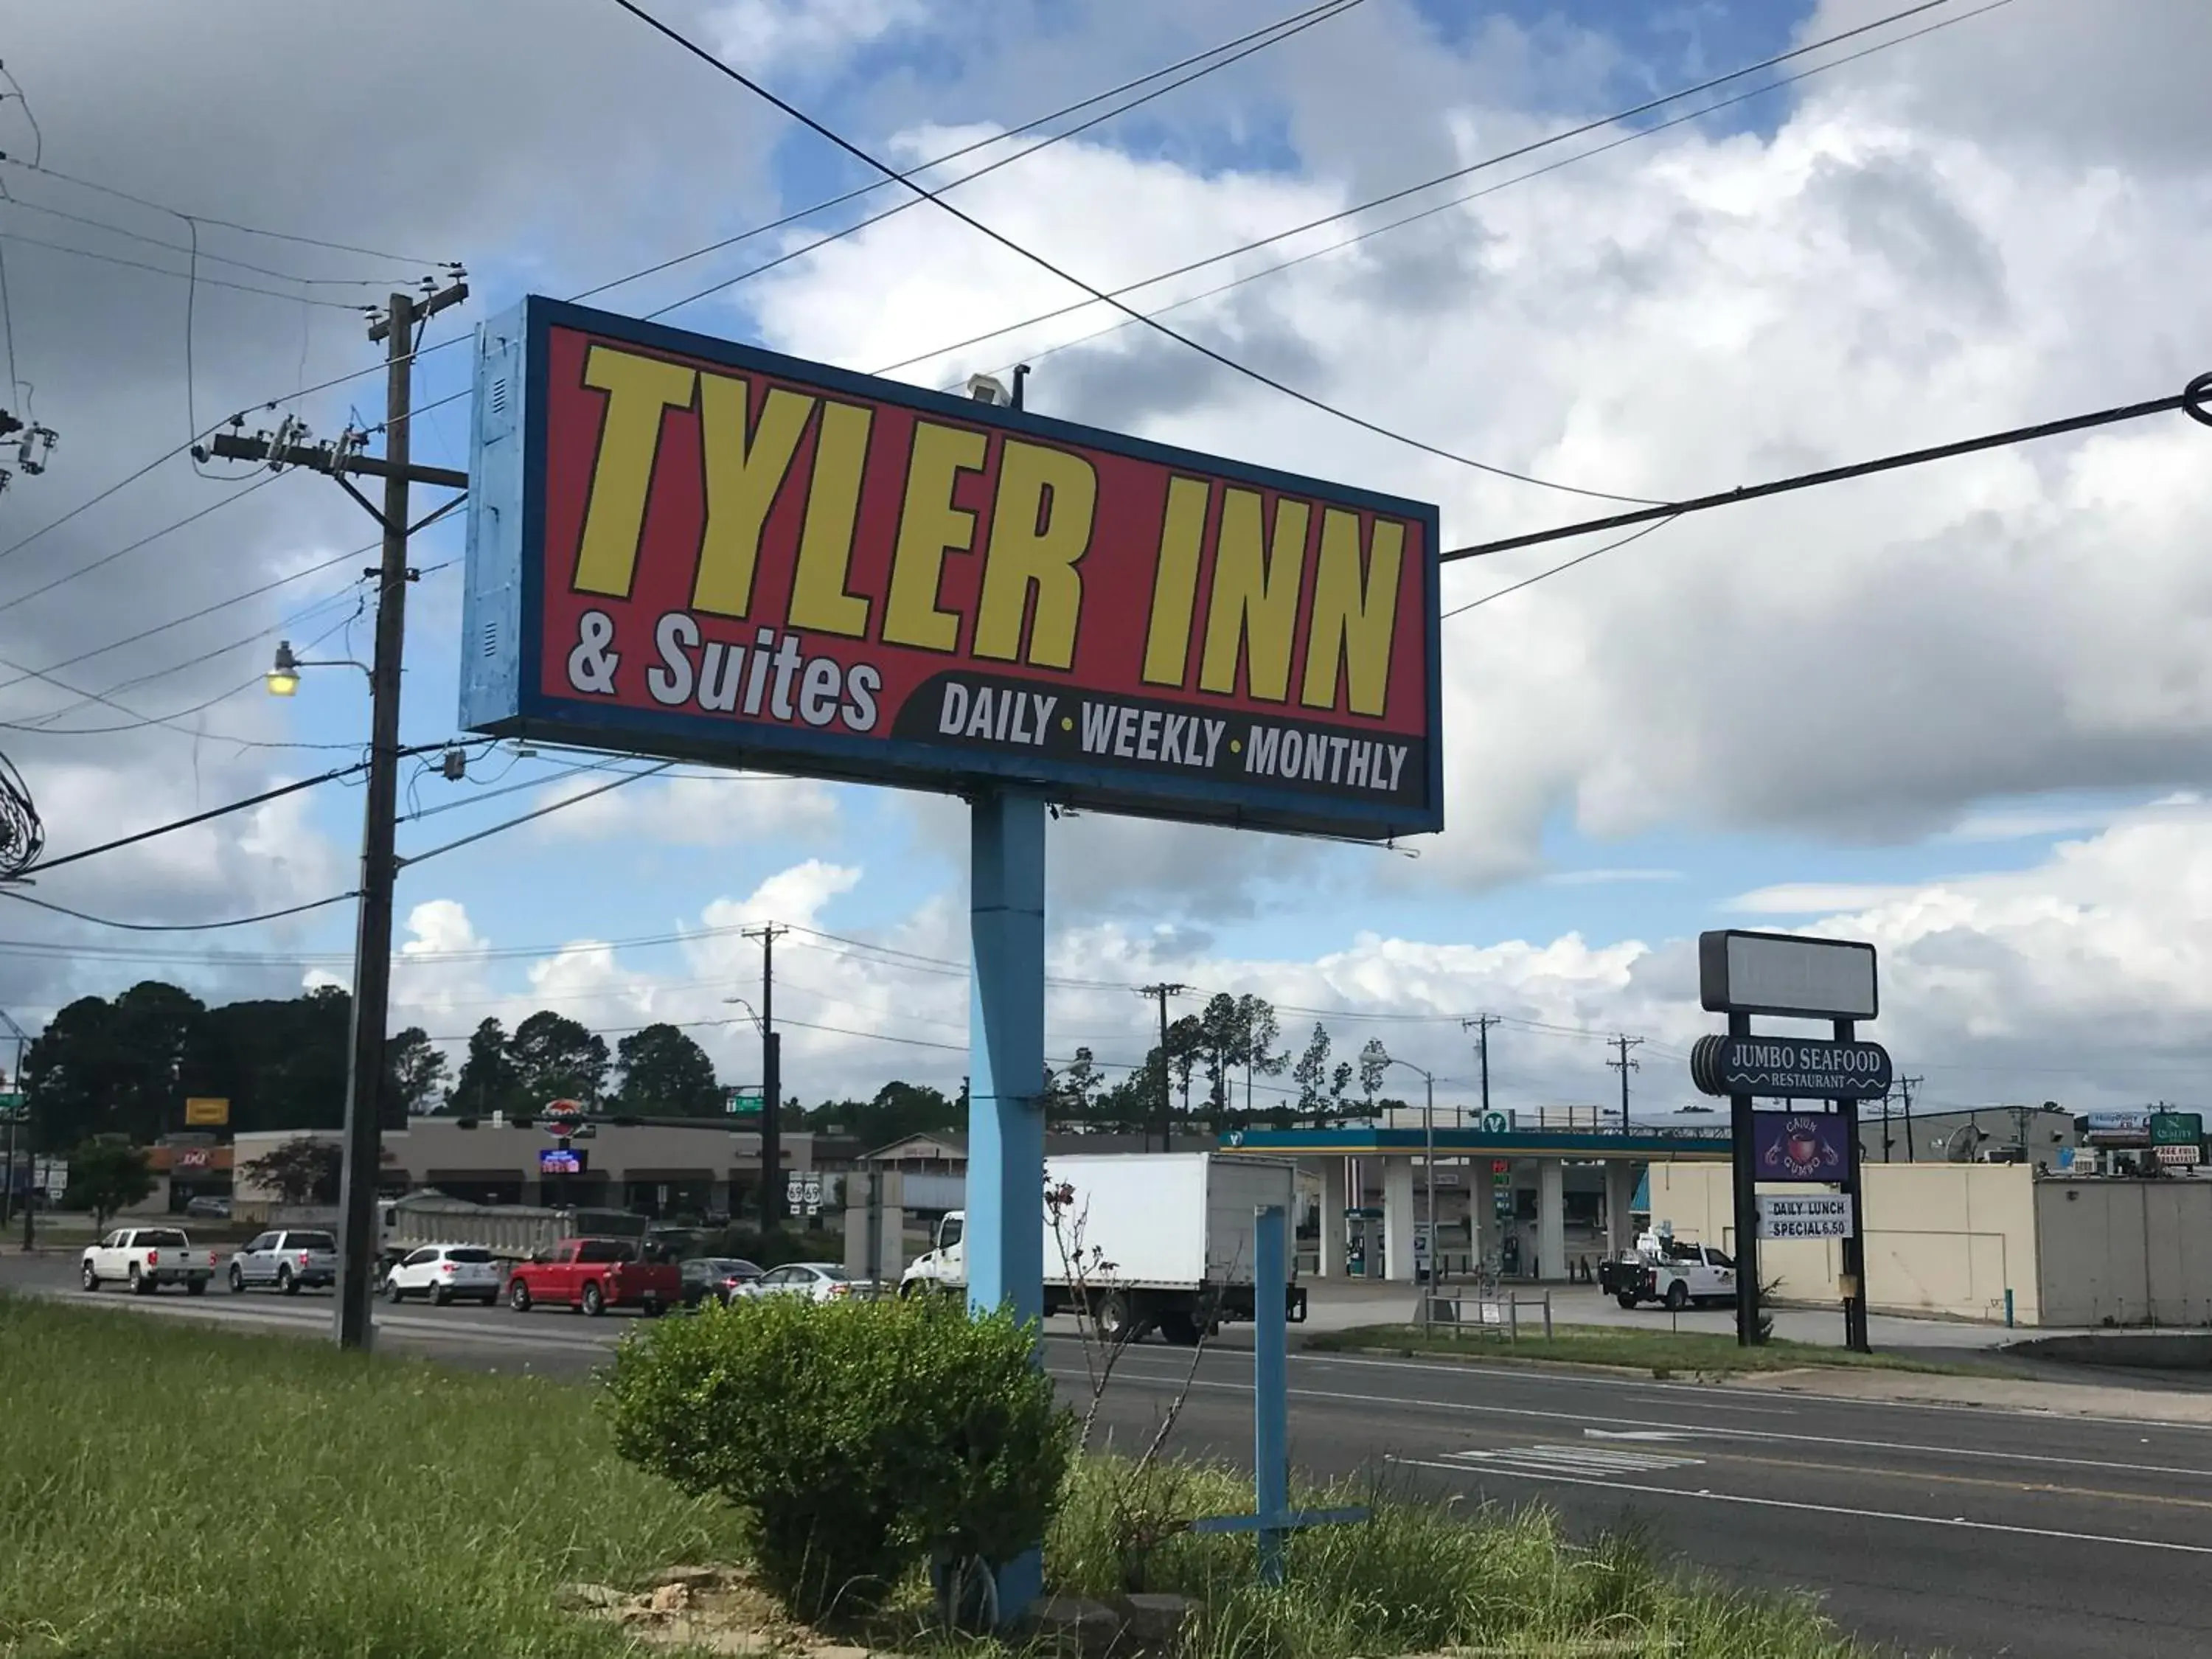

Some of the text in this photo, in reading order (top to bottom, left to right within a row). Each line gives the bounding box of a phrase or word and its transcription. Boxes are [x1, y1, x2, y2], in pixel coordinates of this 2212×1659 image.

[571, 343, 1405, 718] TYLER INN
[568, 611, 883, 732] & Suites
[939, 681, 1408, 792] DAILY WEEKLY MONTHLY
[1732, 1044, 1880, 1072] JUMBO SEAFOOD
[1771, 1072, 1846, 1088] RESTAURANT
[1773, 1202, 1845, 1216] DAILY LUNCH
[1773, 1221, 1821, 1237] SPECIAL
